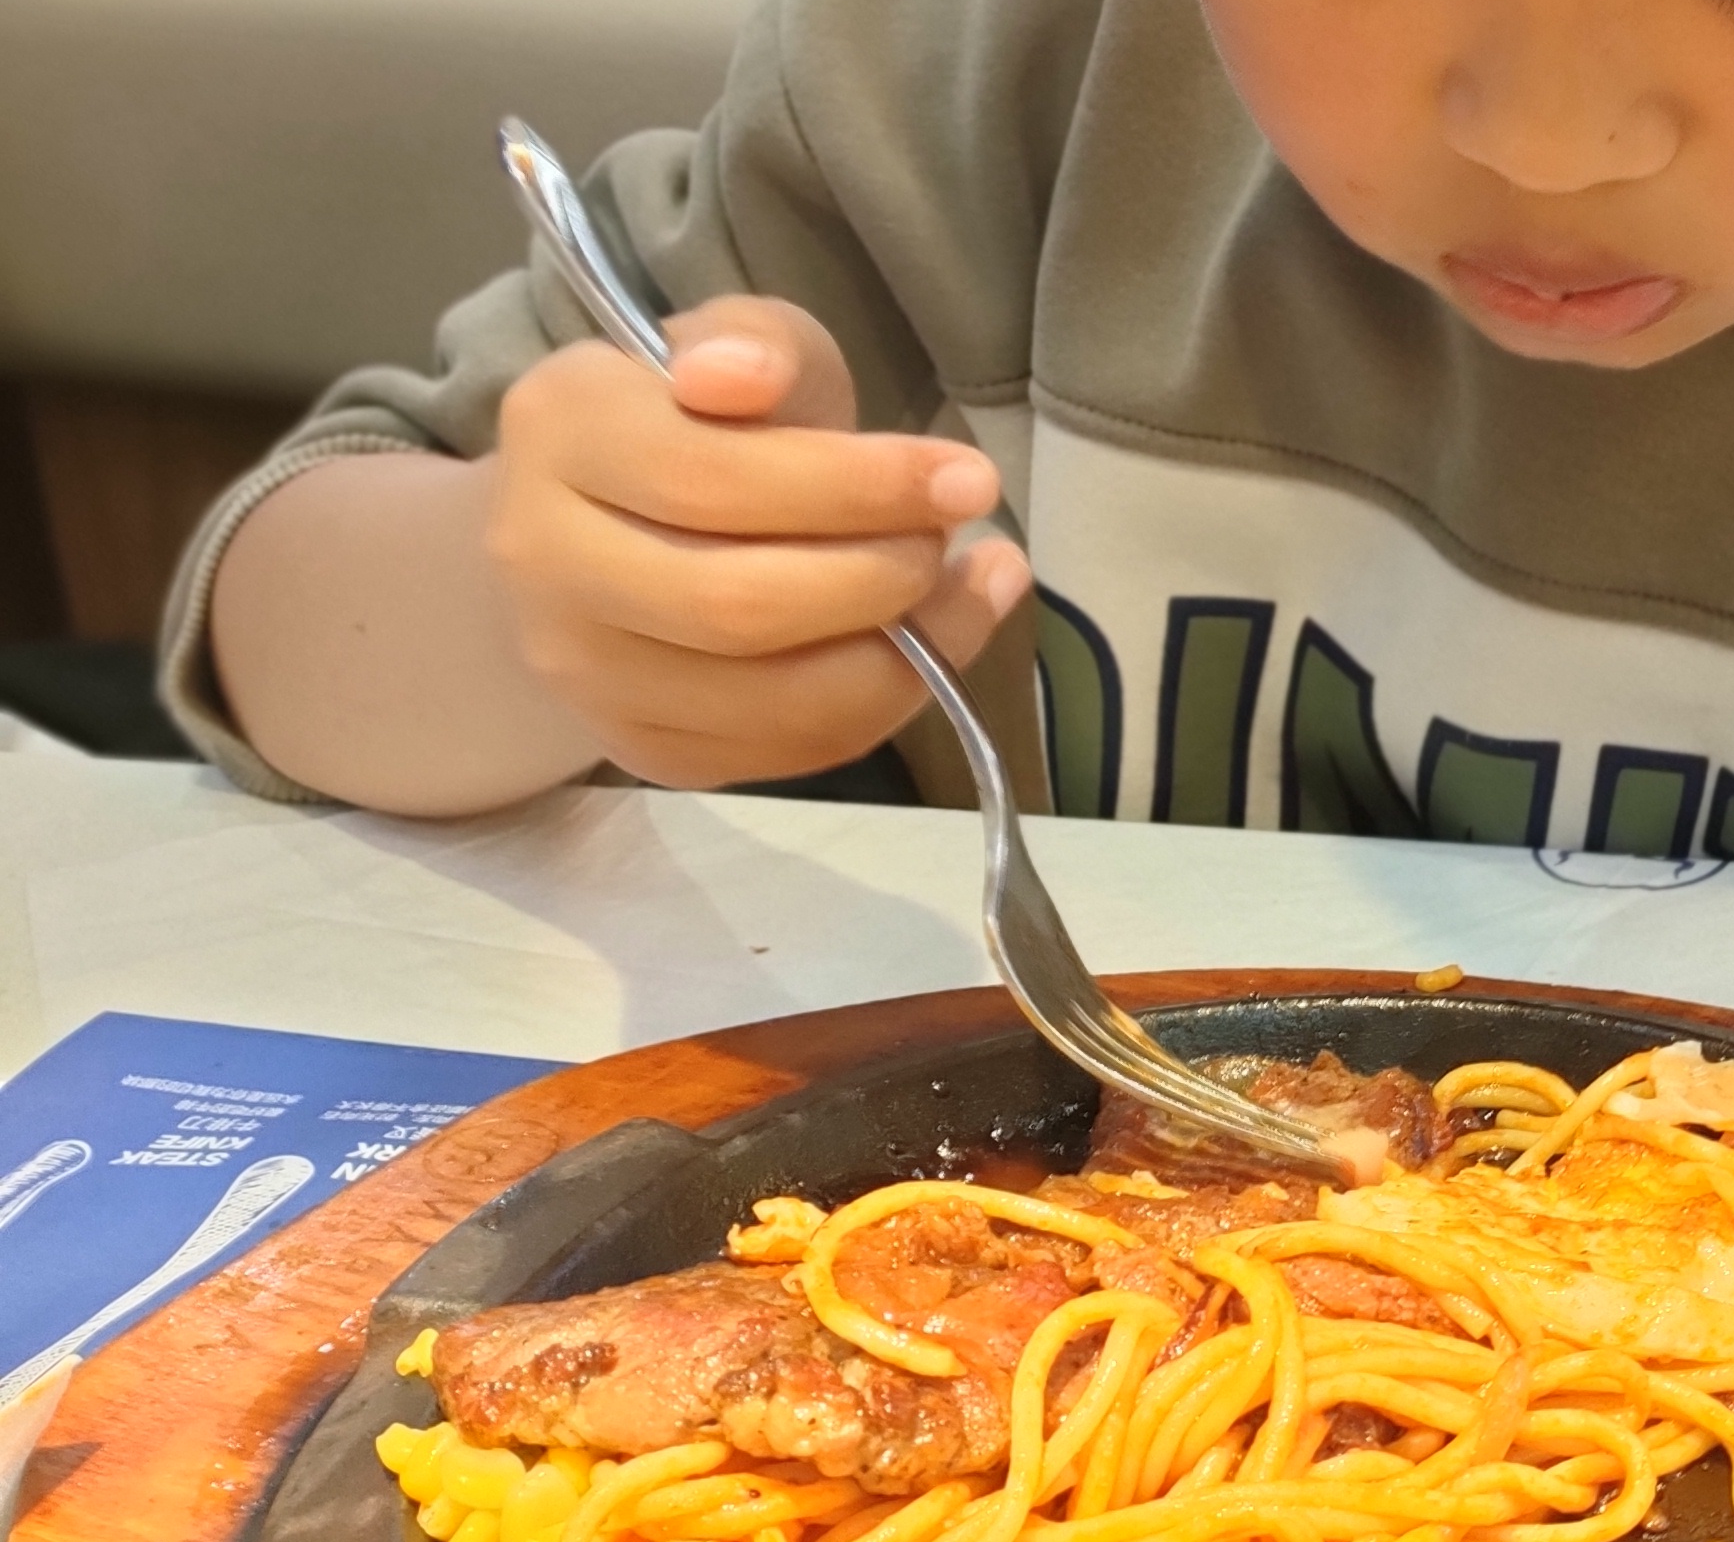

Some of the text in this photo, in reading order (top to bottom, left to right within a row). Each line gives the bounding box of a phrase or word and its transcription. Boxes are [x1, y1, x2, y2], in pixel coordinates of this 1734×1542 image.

[177, 1115, 262, 1132] 牛排刀
[148, 1134, 255, 1151] KNIFE
[108, 1151, 232, 1167] STEAK
